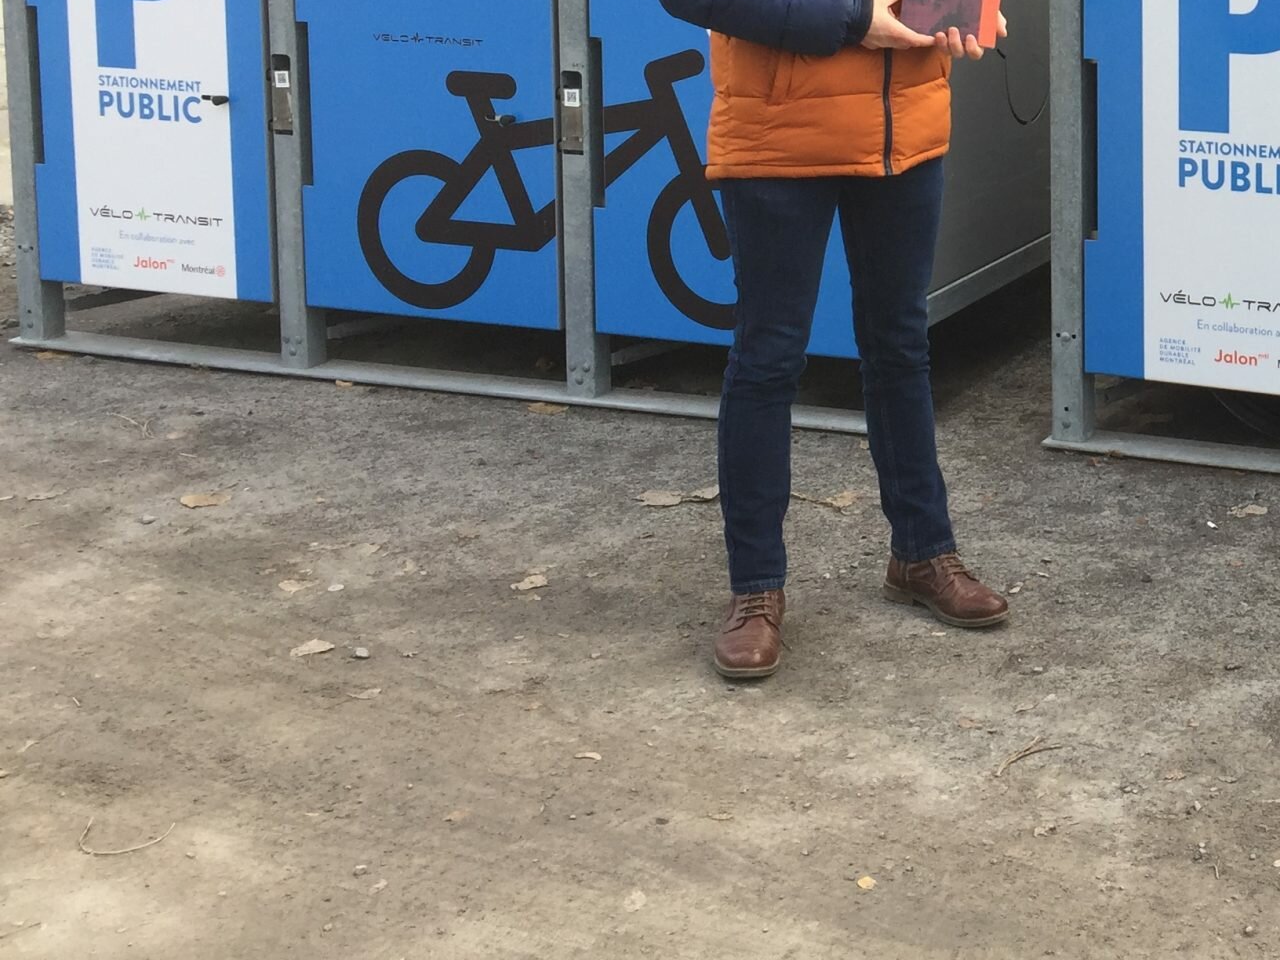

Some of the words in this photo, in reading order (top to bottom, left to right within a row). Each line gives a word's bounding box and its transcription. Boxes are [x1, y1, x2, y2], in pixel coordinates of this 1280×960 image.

[425, 36, 484, 47] TRANSIT
[98, 75, 202, 92] STATIONNEMENT
[98, 90, 202, 123] PUBLIC
[90, 205, 133, 220] VÉLO
[153, 212, 223, 227] TRANSIT
[133, 256, 167, 270] Jalon
[181, 263, 216, 275] Montréal
[1160, 290, 1217, 307] VÉLO
[1197, 319, 1210, 331] En
[1212, 322, 1273, 337] collaboration
[1214, 349, 1258, 366] Jalon
